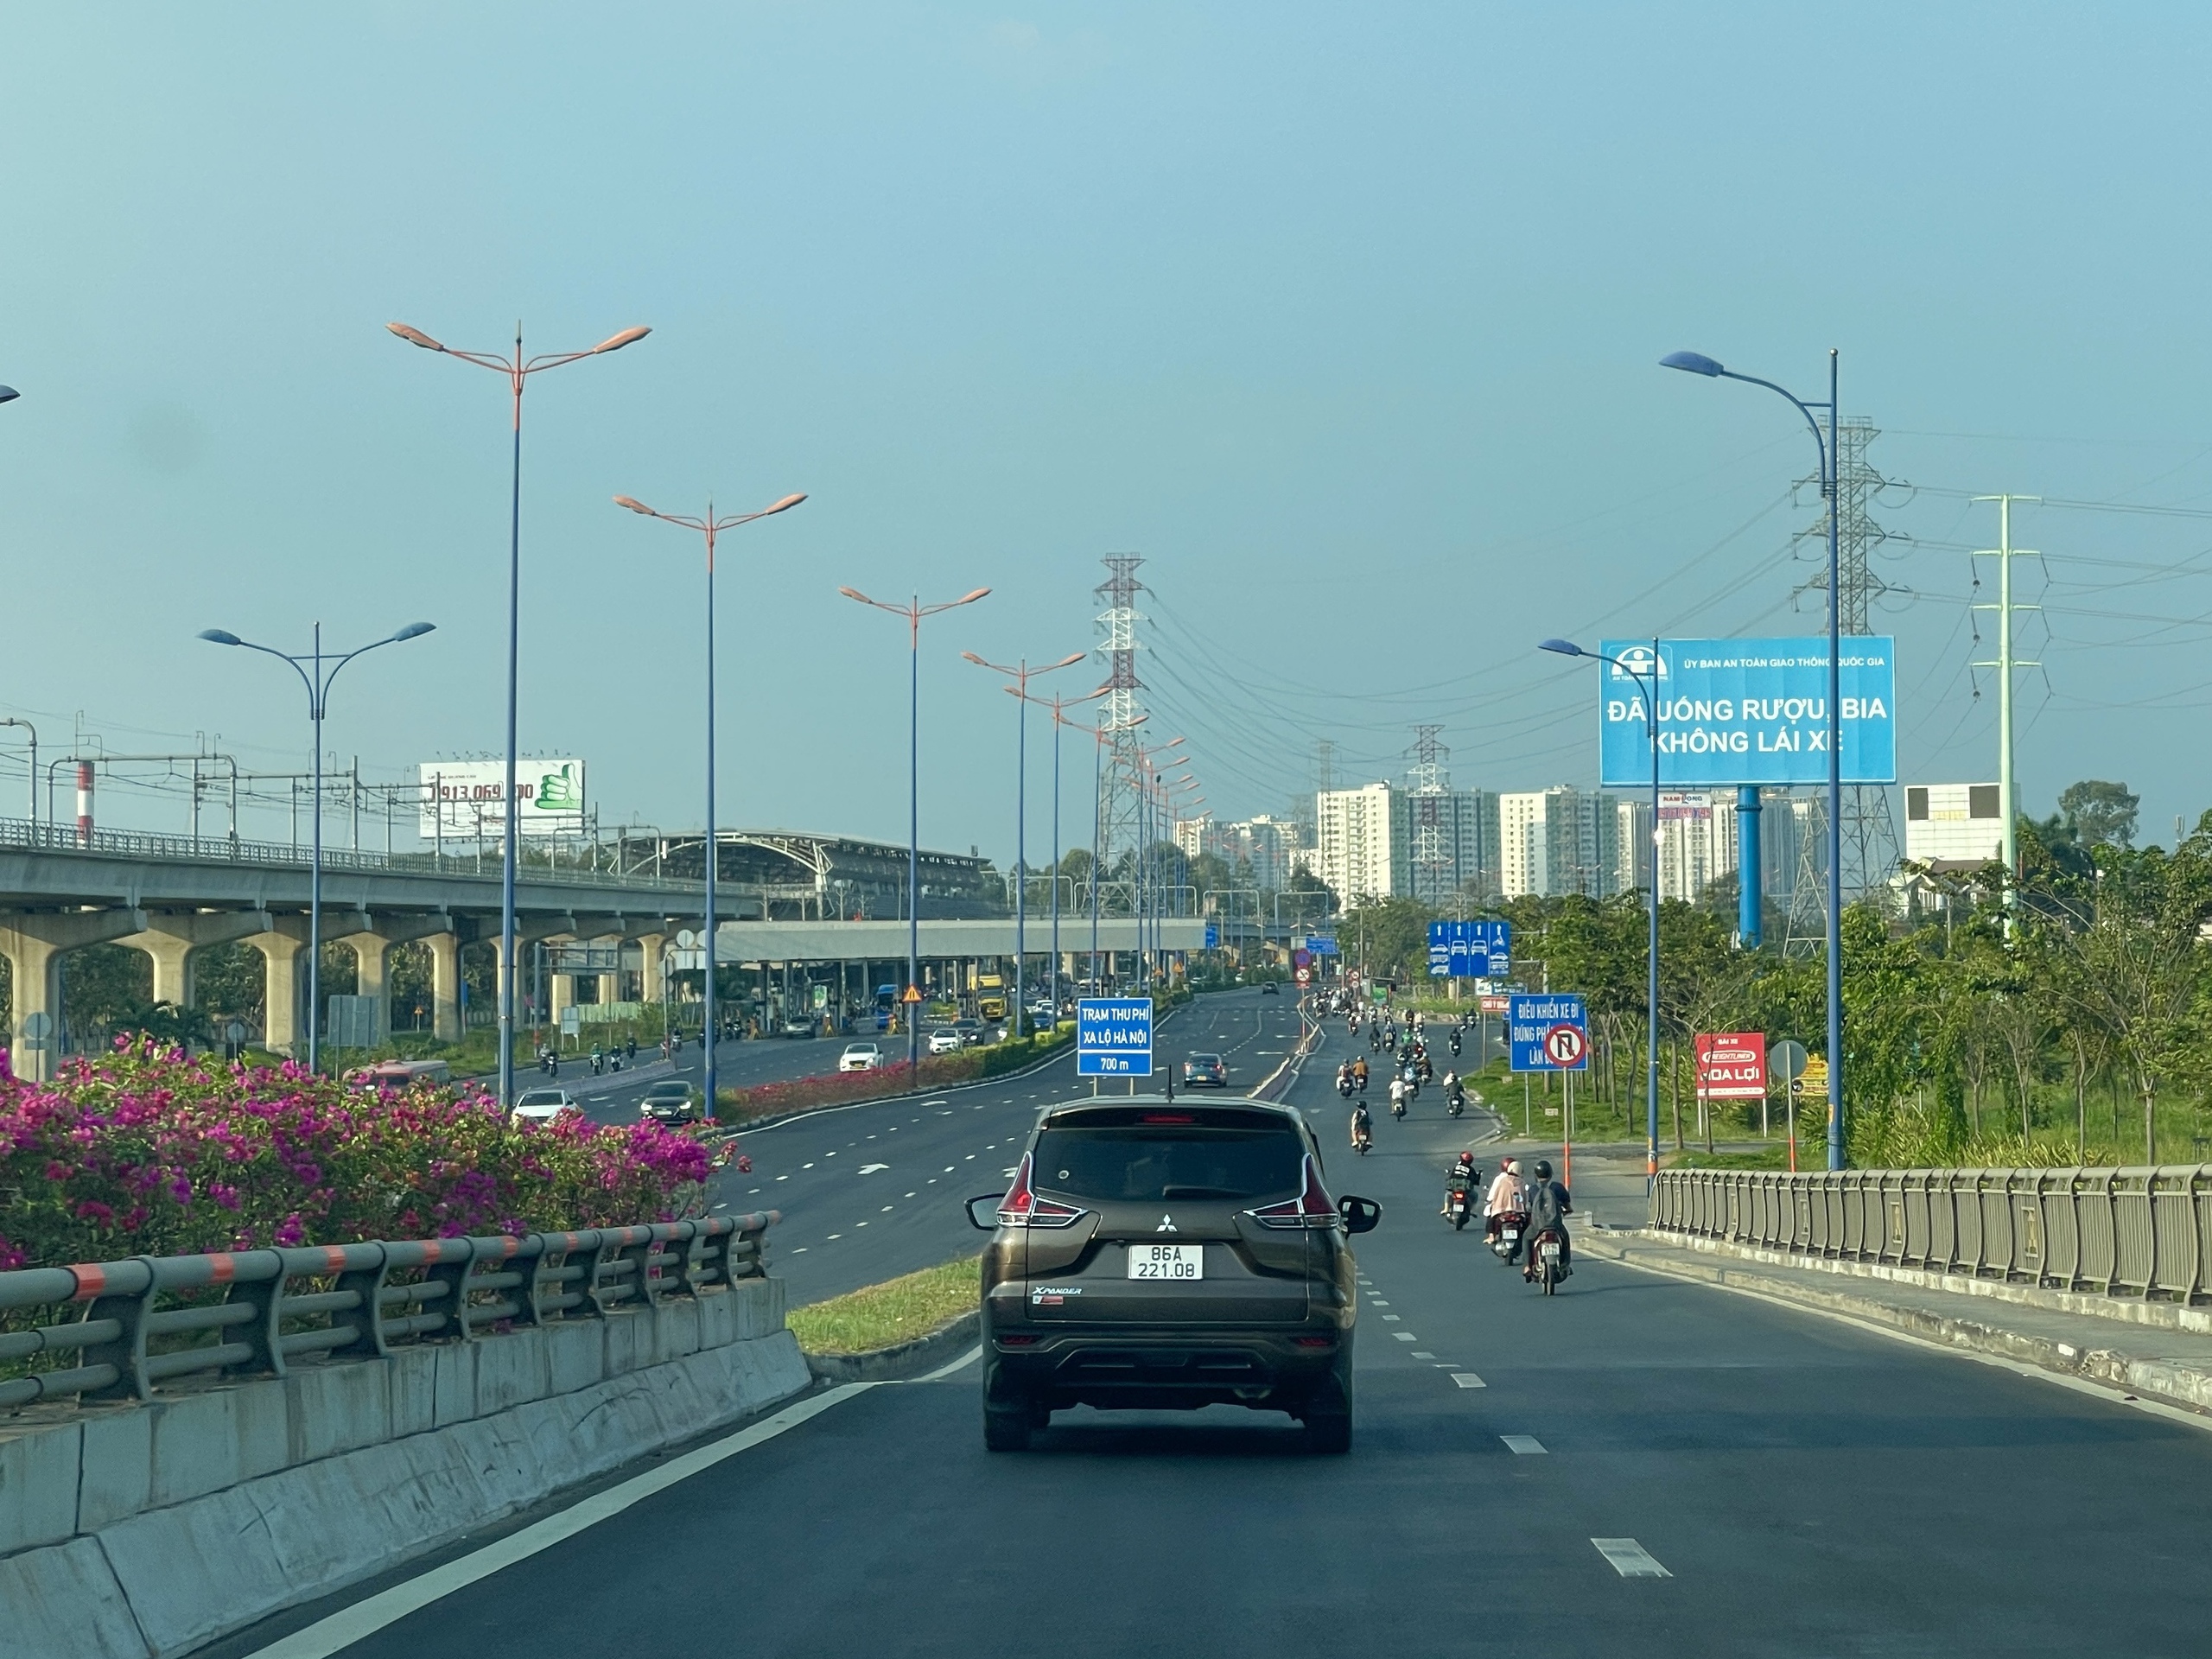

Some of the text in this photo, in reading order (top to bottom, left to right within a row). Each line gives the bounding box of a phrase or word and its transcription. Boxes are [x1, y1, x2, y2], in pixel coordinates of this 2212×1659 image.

[1700, 659, 1721, 669] BAN
[1723, 659, 1738, 668] AN
[1739, 657, 1768, 668] TOÀN
[1769, 658, 1796, 667] GIAO
[1866, 657, 1885, 666] GIA
[1607, 696, 1647, 721] ĐÃ
[1656, 696, 1734, 721] UỐNG
[1841, 697, 1888, 719] BIA
[1650, 727, 1749, 753] KHÔNG
[1758, 726, 1800, 752] LÁI
[473, 785, 501, 799] 069
[1082, 1005, 1150, 1024] TRẠM THU PHÍ
[1518, 998, 1535, 1019] ĐIỀU
[1536, 997, 1559, 1019] KHIỂN
[1560, 1003, 1570, 1019] XE
[1571, 1002, 1579, 1018] ĐI
[1084, 1028, 1147, 1046] XA LỘ HÀ NỘI
[1514, 1024, 1535, 1042] ĐÚNG
[1100, 1058, 1128, 1071] 700 m
[1529, 1046, 1543, 1065] LÀN
[1734, 1065, 1760, 1082] LỢI
[1151, 1246, 1182, 1262] 86A
[1138, 1262, 1195, 1278] 221.08
